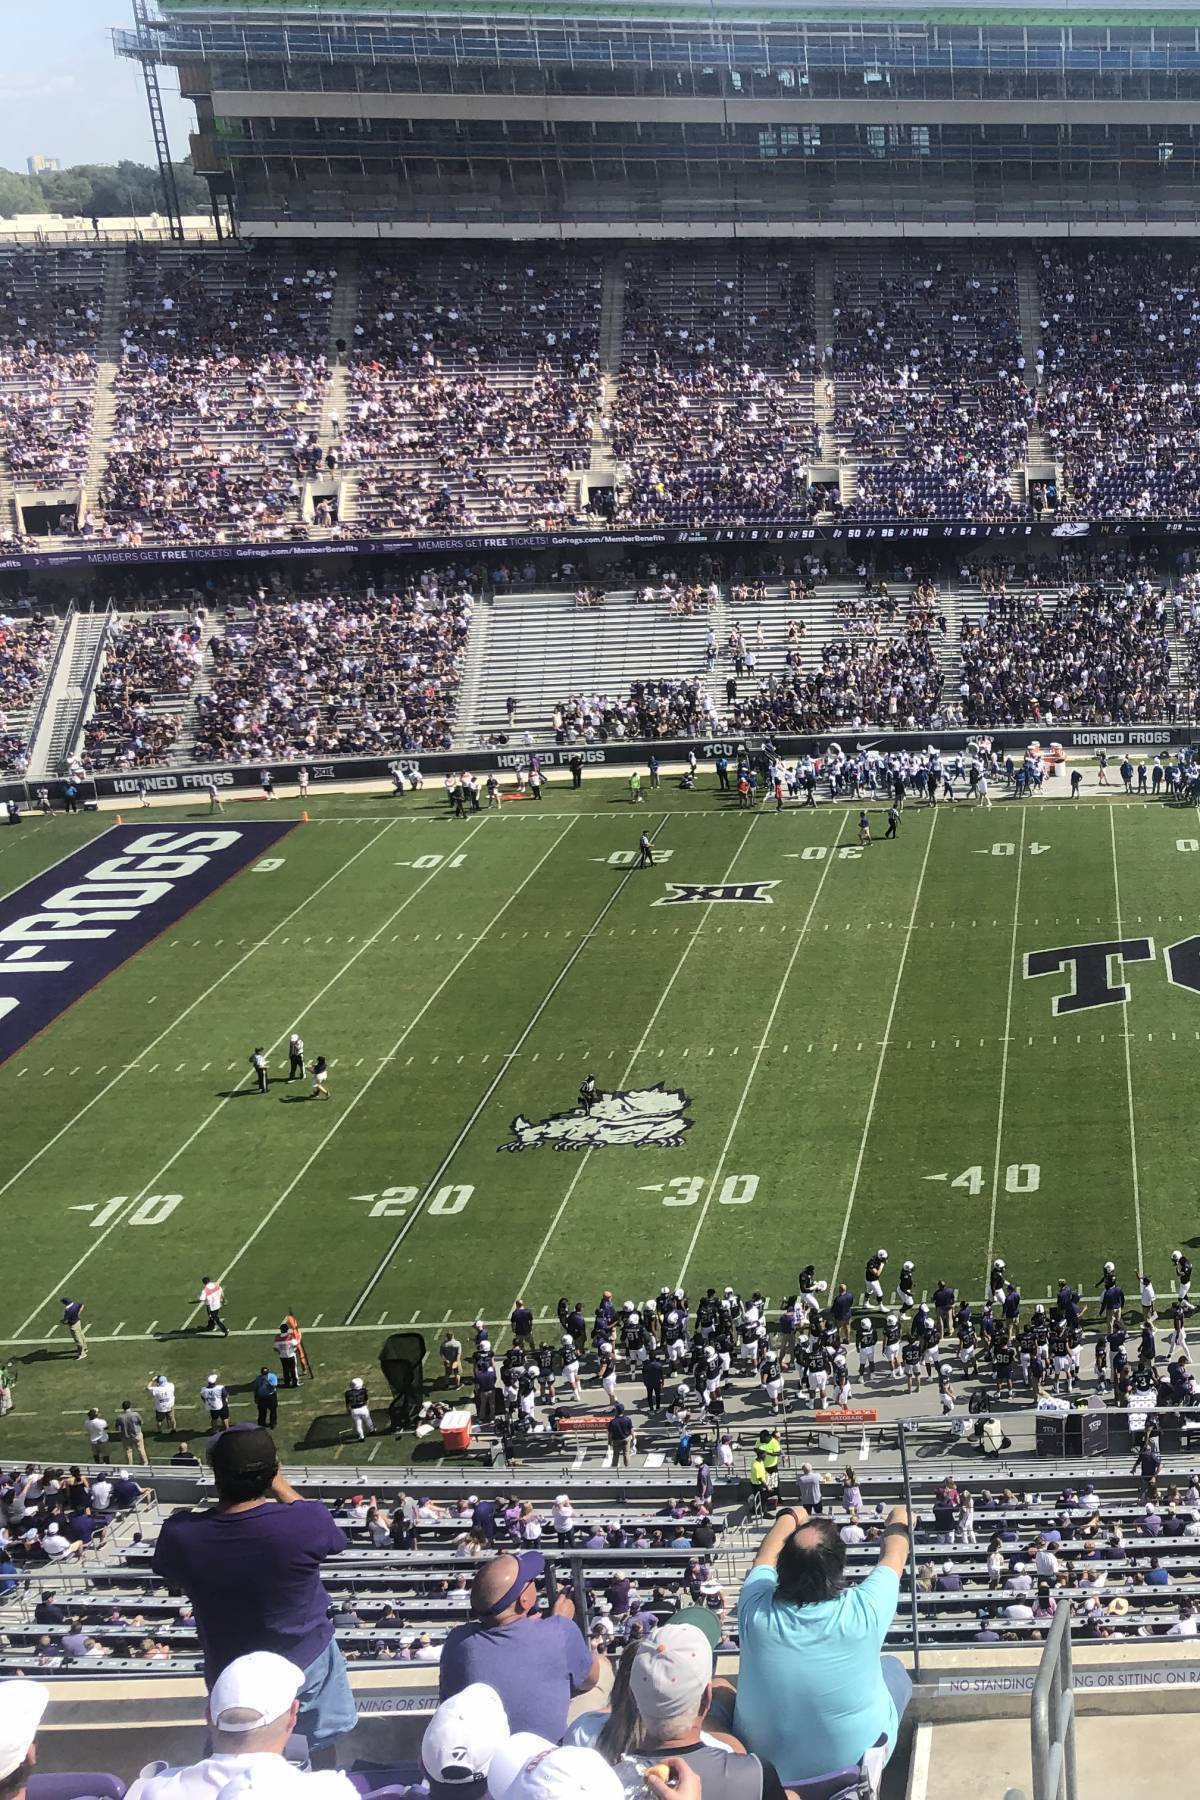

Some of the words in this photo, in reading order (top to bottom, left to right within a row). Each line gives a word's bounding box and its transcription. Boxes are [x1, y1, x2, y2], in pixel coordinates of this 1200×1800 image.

[418, 540, 463, 550] MEMBERS
[465, 539, 483, 548] GET
[484, 537, 508, 547] FREE
[509, 536, 549, 546] TICKETS!
[552, 534, 665, 545] GoFrogs.com/MemberBenefits
[88, 552, 138, 563] MEMBERS
[140, 551, 159, 561] GET
[161, 550, 188, 560] FREE
[189, 549, 232, 559] TICKETS!
[236, 545, 358, 558] GoFrogs.com/MemberBenefits
[1073, 732, 1125, 745] HORNED
[1129, 732, 1171, 744] FROGS
[703, 743, 734, 758] TCU
[387, 760, 419, 774] TCU
[182, 773, 234, 788] FROGS
[800, 846, 865, 861] 30
[991, 842, 1051, 857] 40
[411, 854, 467, 869] 10
[951, 1162, 1042, 1195] 40
[661, 1174, 762, 1207] 30
[368, 1184, 475, 1218] 20
[89, 1194, 184, 1228] 10
[809, 1358, 824, 1368] 43
[905, 1351, 920, 1361] 33
[996, 1354, 1010, 1364] 96
[950, 1679, 969, 1692] NO
[973, 1677, 1034, 1692] STANDING
[1098, 1674, 1114, 1687] OR
[1166, 1671, 1186, 1684] ON
[396, 1698, 414, 1711] OR
